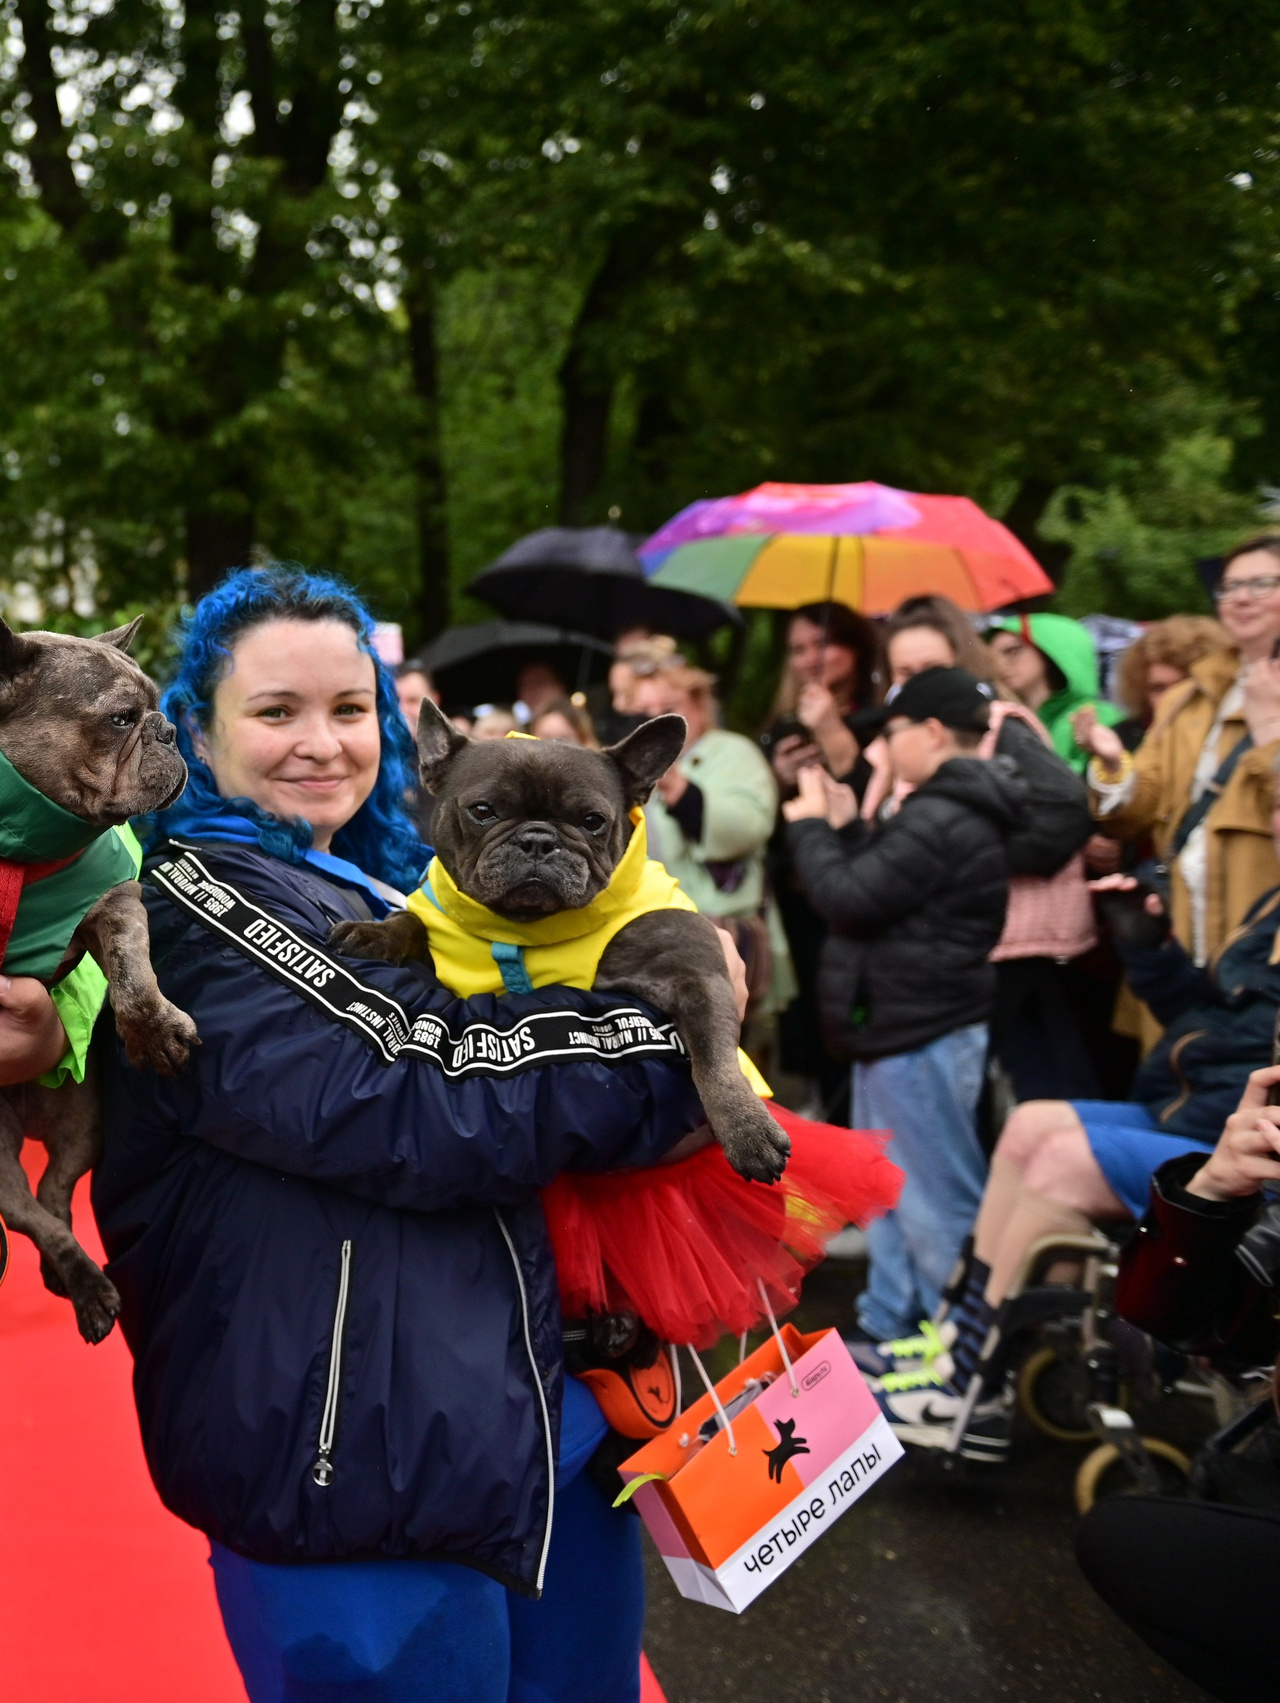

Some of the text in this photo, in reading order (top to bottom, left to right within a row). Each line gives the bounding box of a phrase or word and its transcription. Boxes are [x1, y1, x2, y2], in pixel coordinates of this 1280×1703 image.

[203, 897, 229, 918] 1985
[243, 918, 336, 988] SATISFIED
[345, 1001, 386, 1029] INSTINCT
[412, 1029, 441, 1049] 1985
[452, 1026, 536, 1068] SATISFIED
[743, 1443, 882, 1572] четыре лапы
